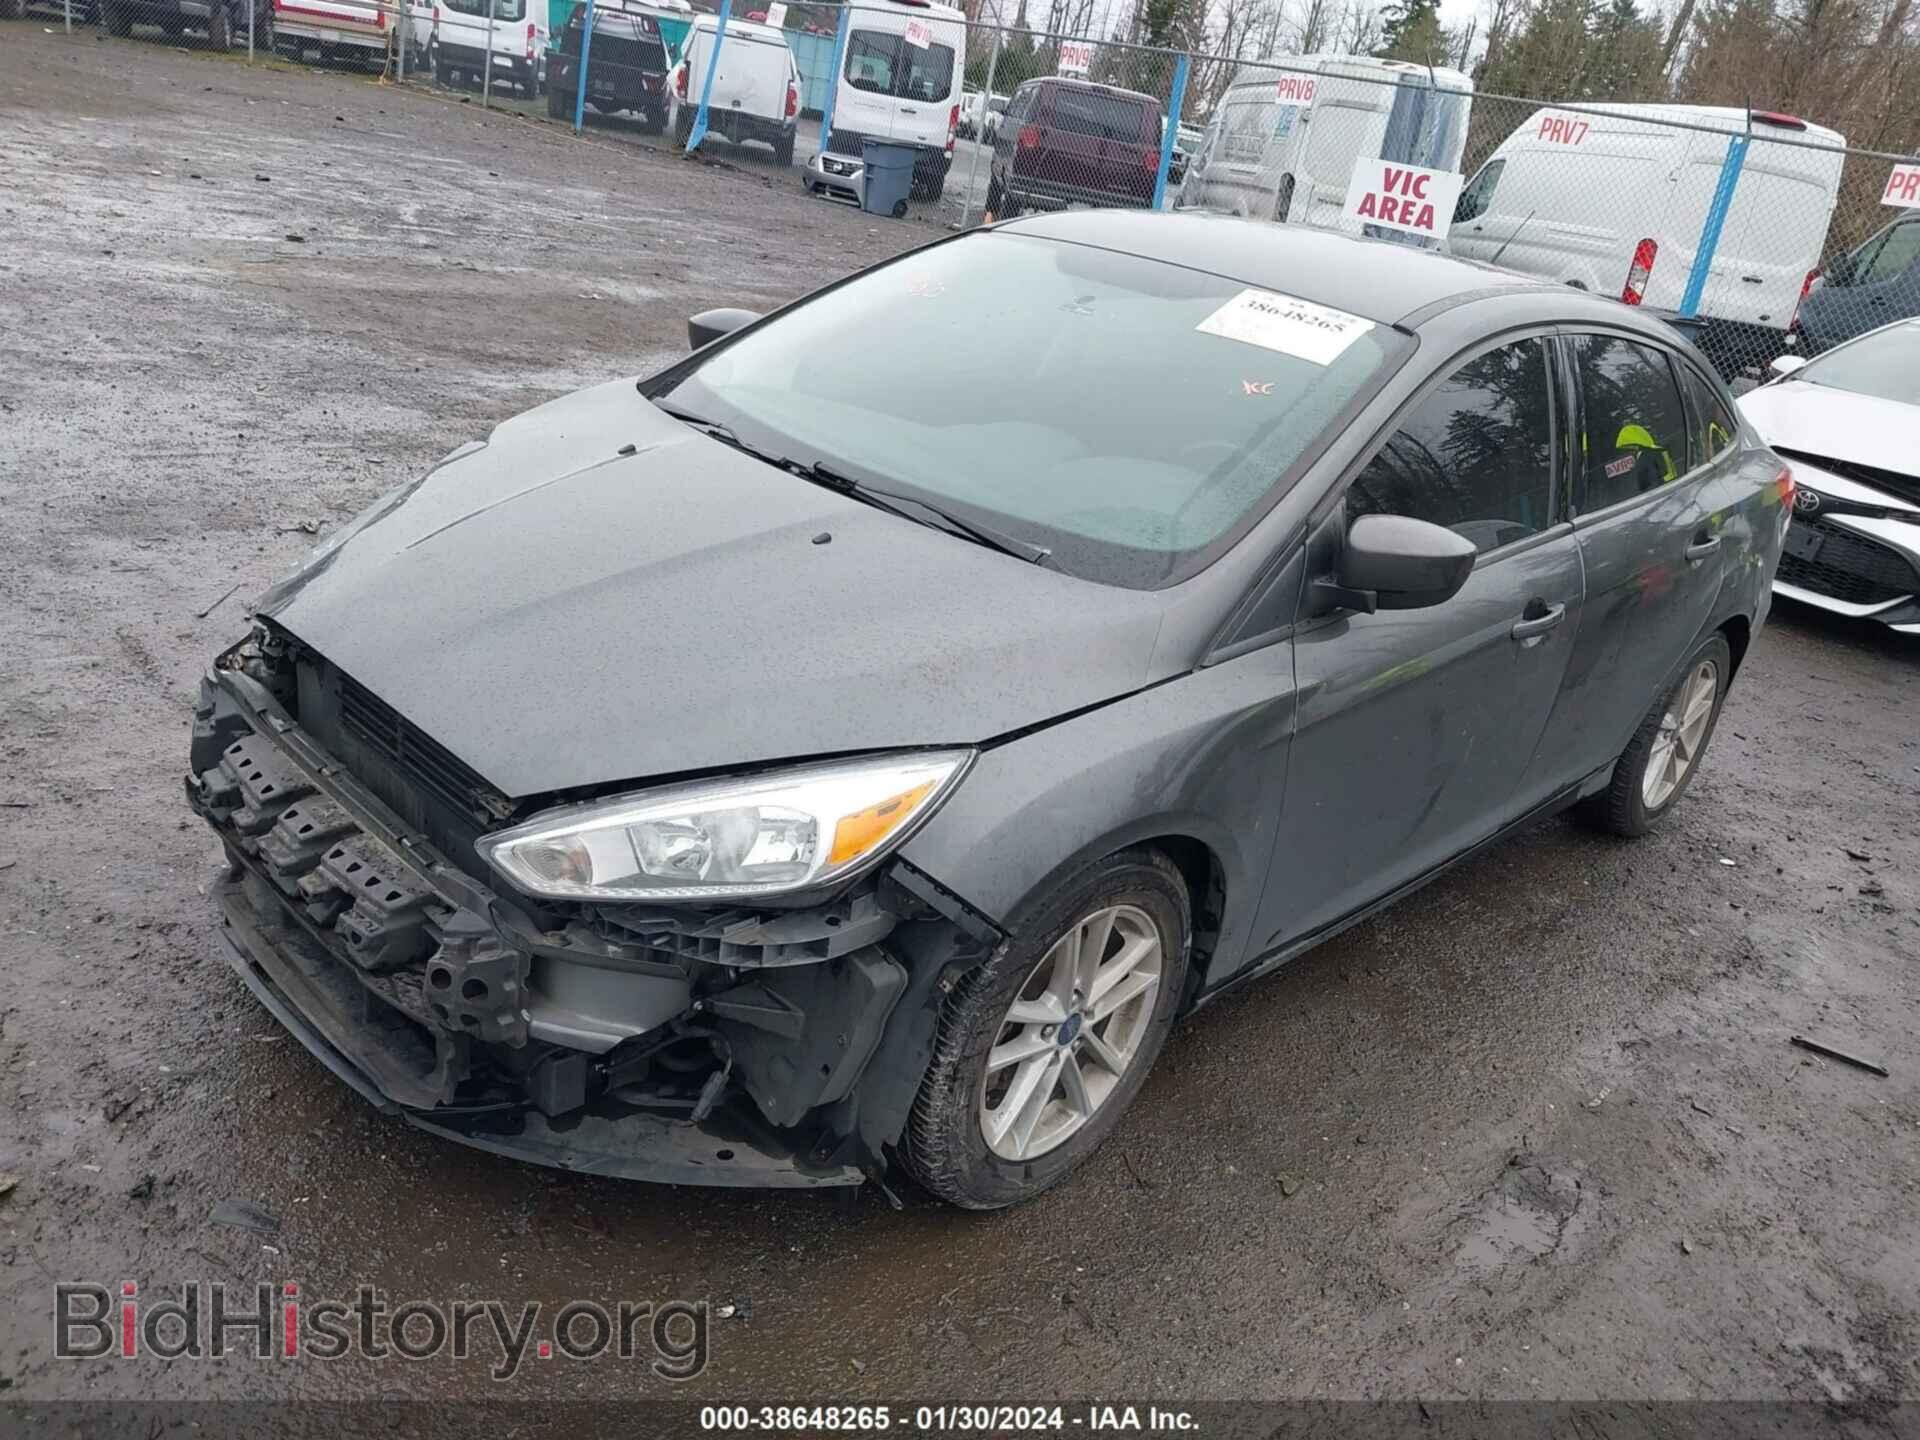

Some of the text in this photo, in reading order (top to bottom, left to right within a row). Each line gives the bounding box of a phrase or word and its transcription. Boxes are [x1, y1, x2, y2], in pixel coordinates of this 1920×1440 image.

[1060, 46, 1090, 67] PRV9
[1278, 78, 1315, 101] PRV8
[1538, 117, 1589, 145] PRV7
[1383, 167, 1431, 200] VIC
[1357, 191, 1435, 231] AREA
